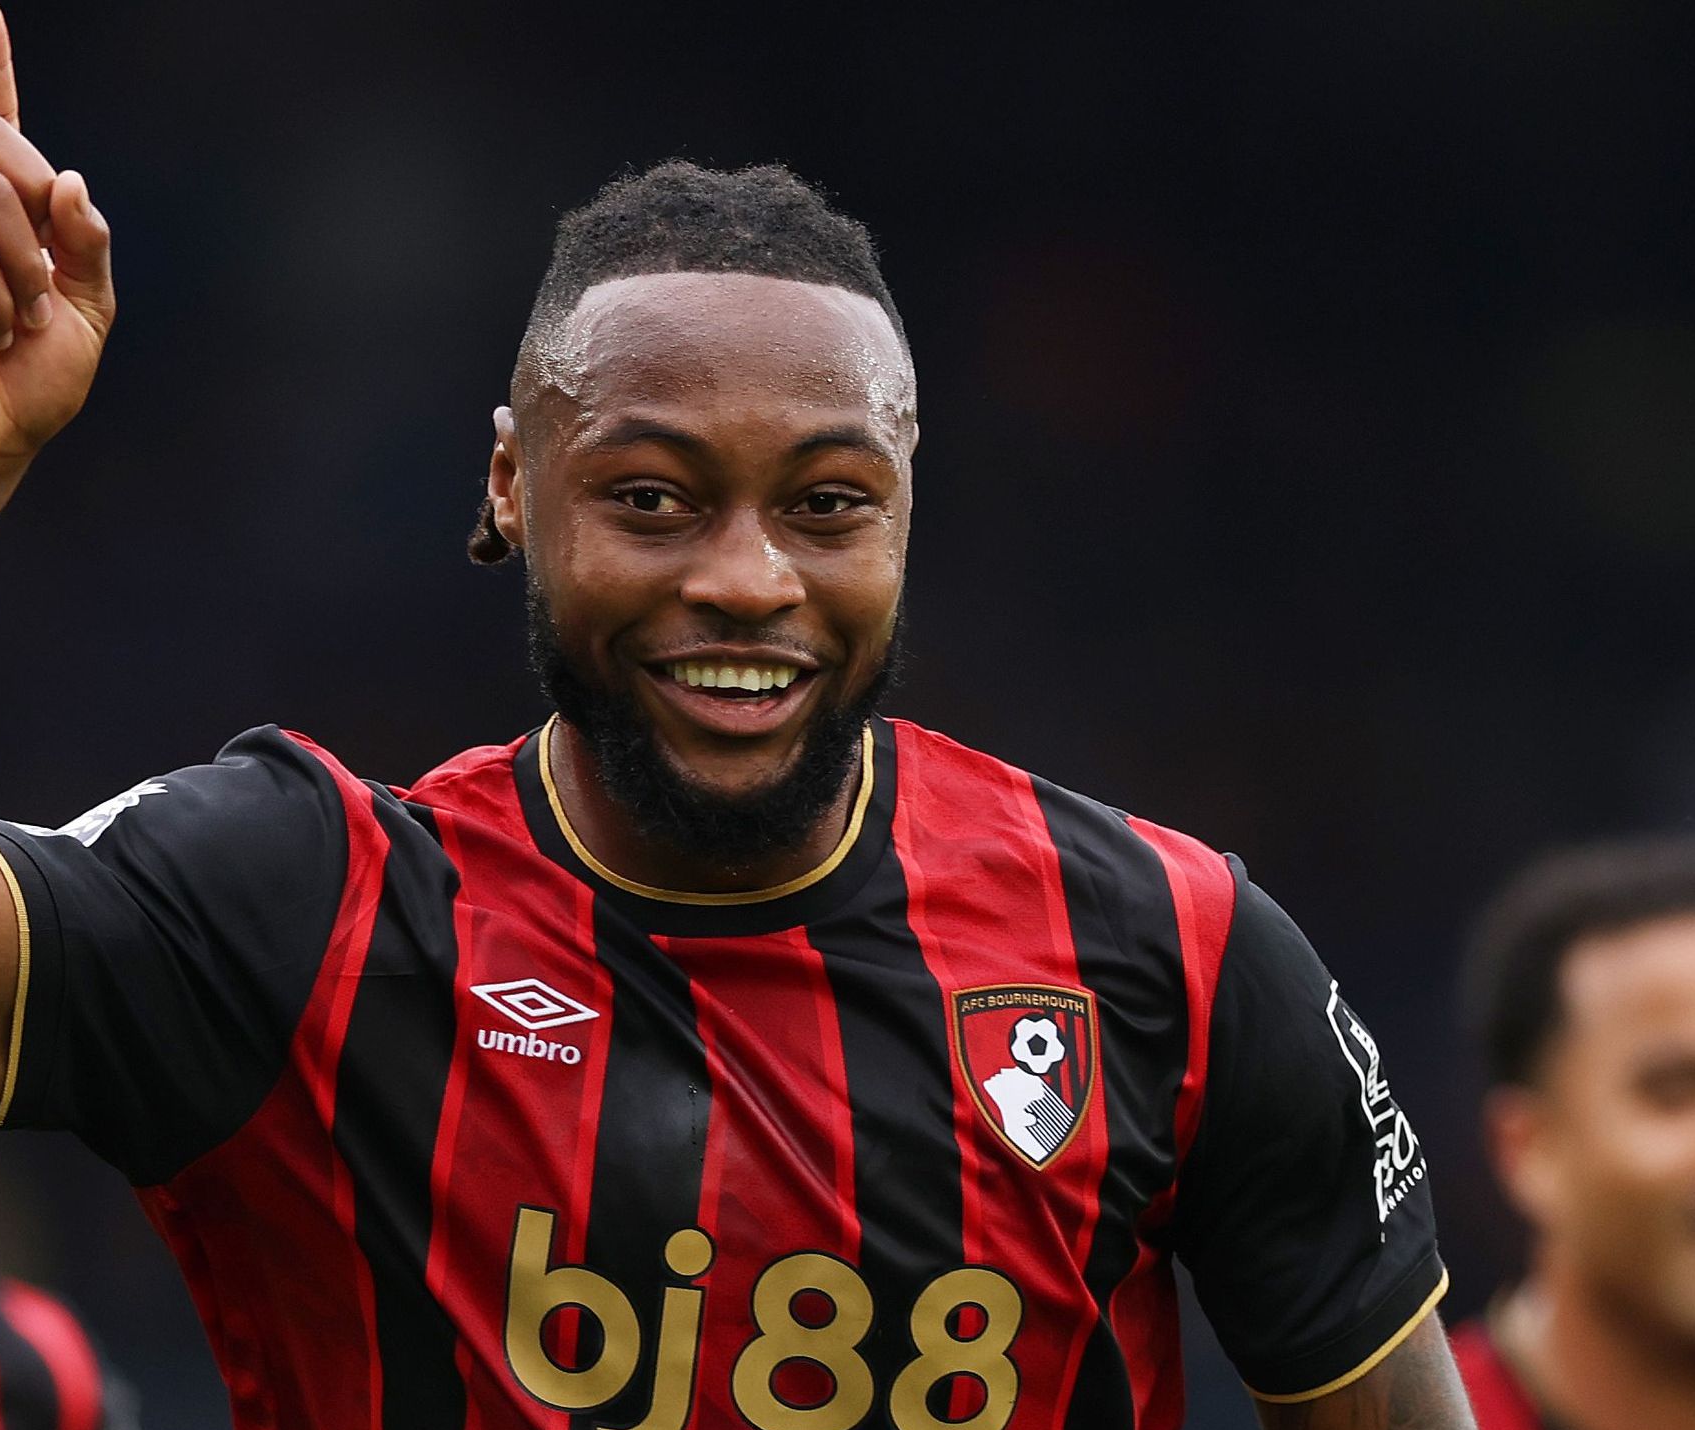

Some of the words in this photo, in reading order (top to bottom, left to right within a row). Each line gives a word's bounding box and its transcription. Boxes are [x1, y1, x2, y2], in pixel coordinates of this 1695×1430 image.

[961, 997, 986, 1012] AFC
[987, 993, 1085, 1014] BOURNEMOUTH
[477, 1029, 582, 1065] umbro
